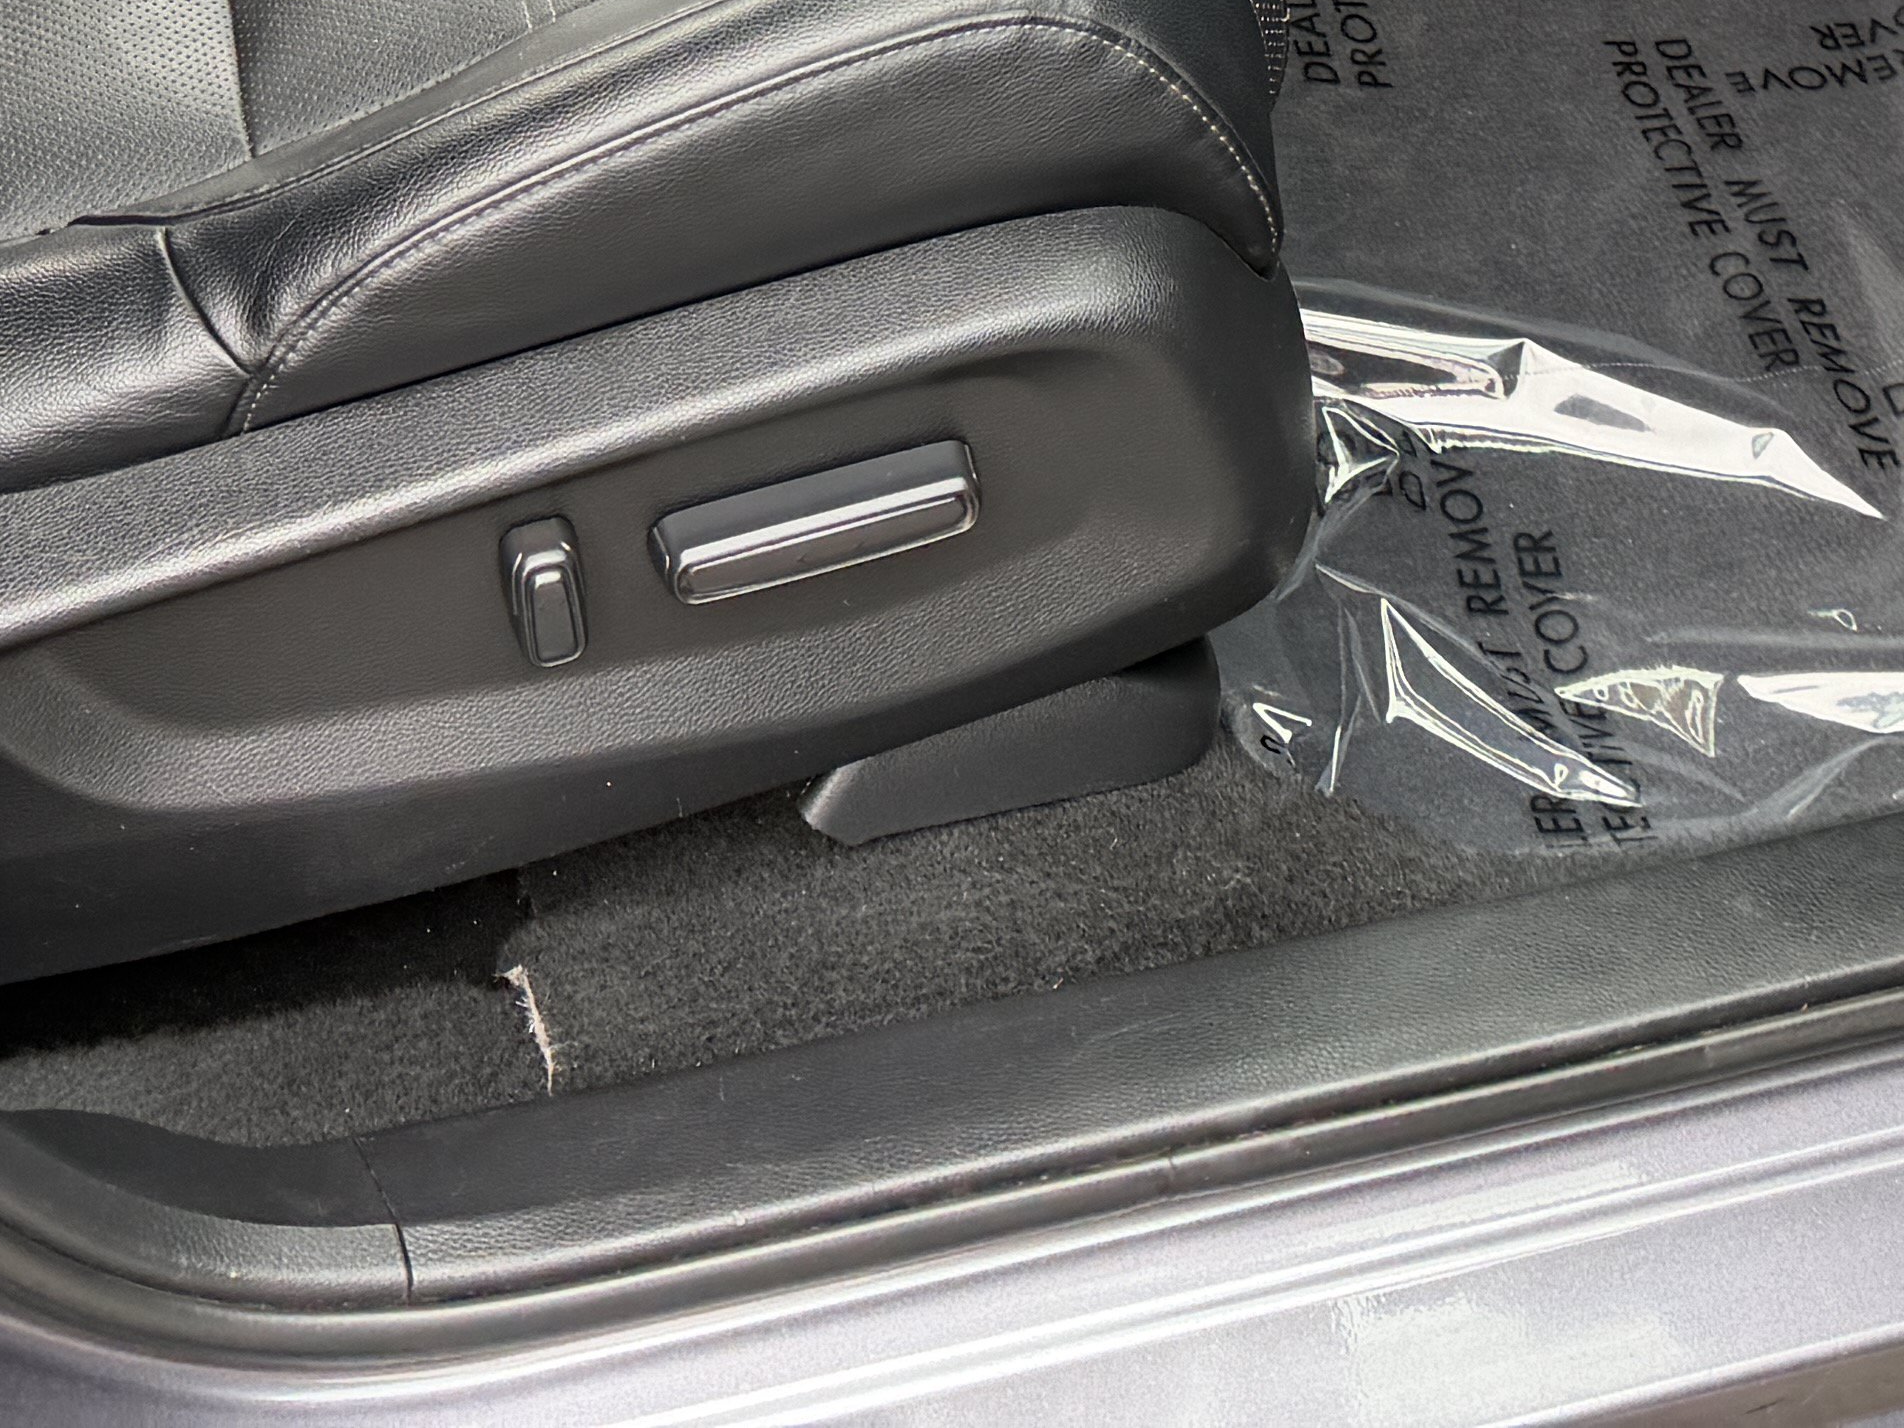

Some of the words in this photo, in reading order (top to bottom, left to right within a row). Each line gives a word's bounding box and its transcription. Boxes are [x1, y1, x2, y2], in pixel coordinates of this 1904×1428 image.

[1603, 39, 1731, 238] PROTECTIVE
[1707, 250, 1799, 371] COVER
[1654, 38, 1743, 152] DEALER
[1723, 178, 1810, 272] MUST
[1787, 297, 1901, 471] REMOVE
[1429, 456, 1509, 618] REMOV
[1513, 529, 1590, 676] COVER
[1530, 794, 1593, 849] LER
[1558, 697, 1659, 846] TECTIVE
